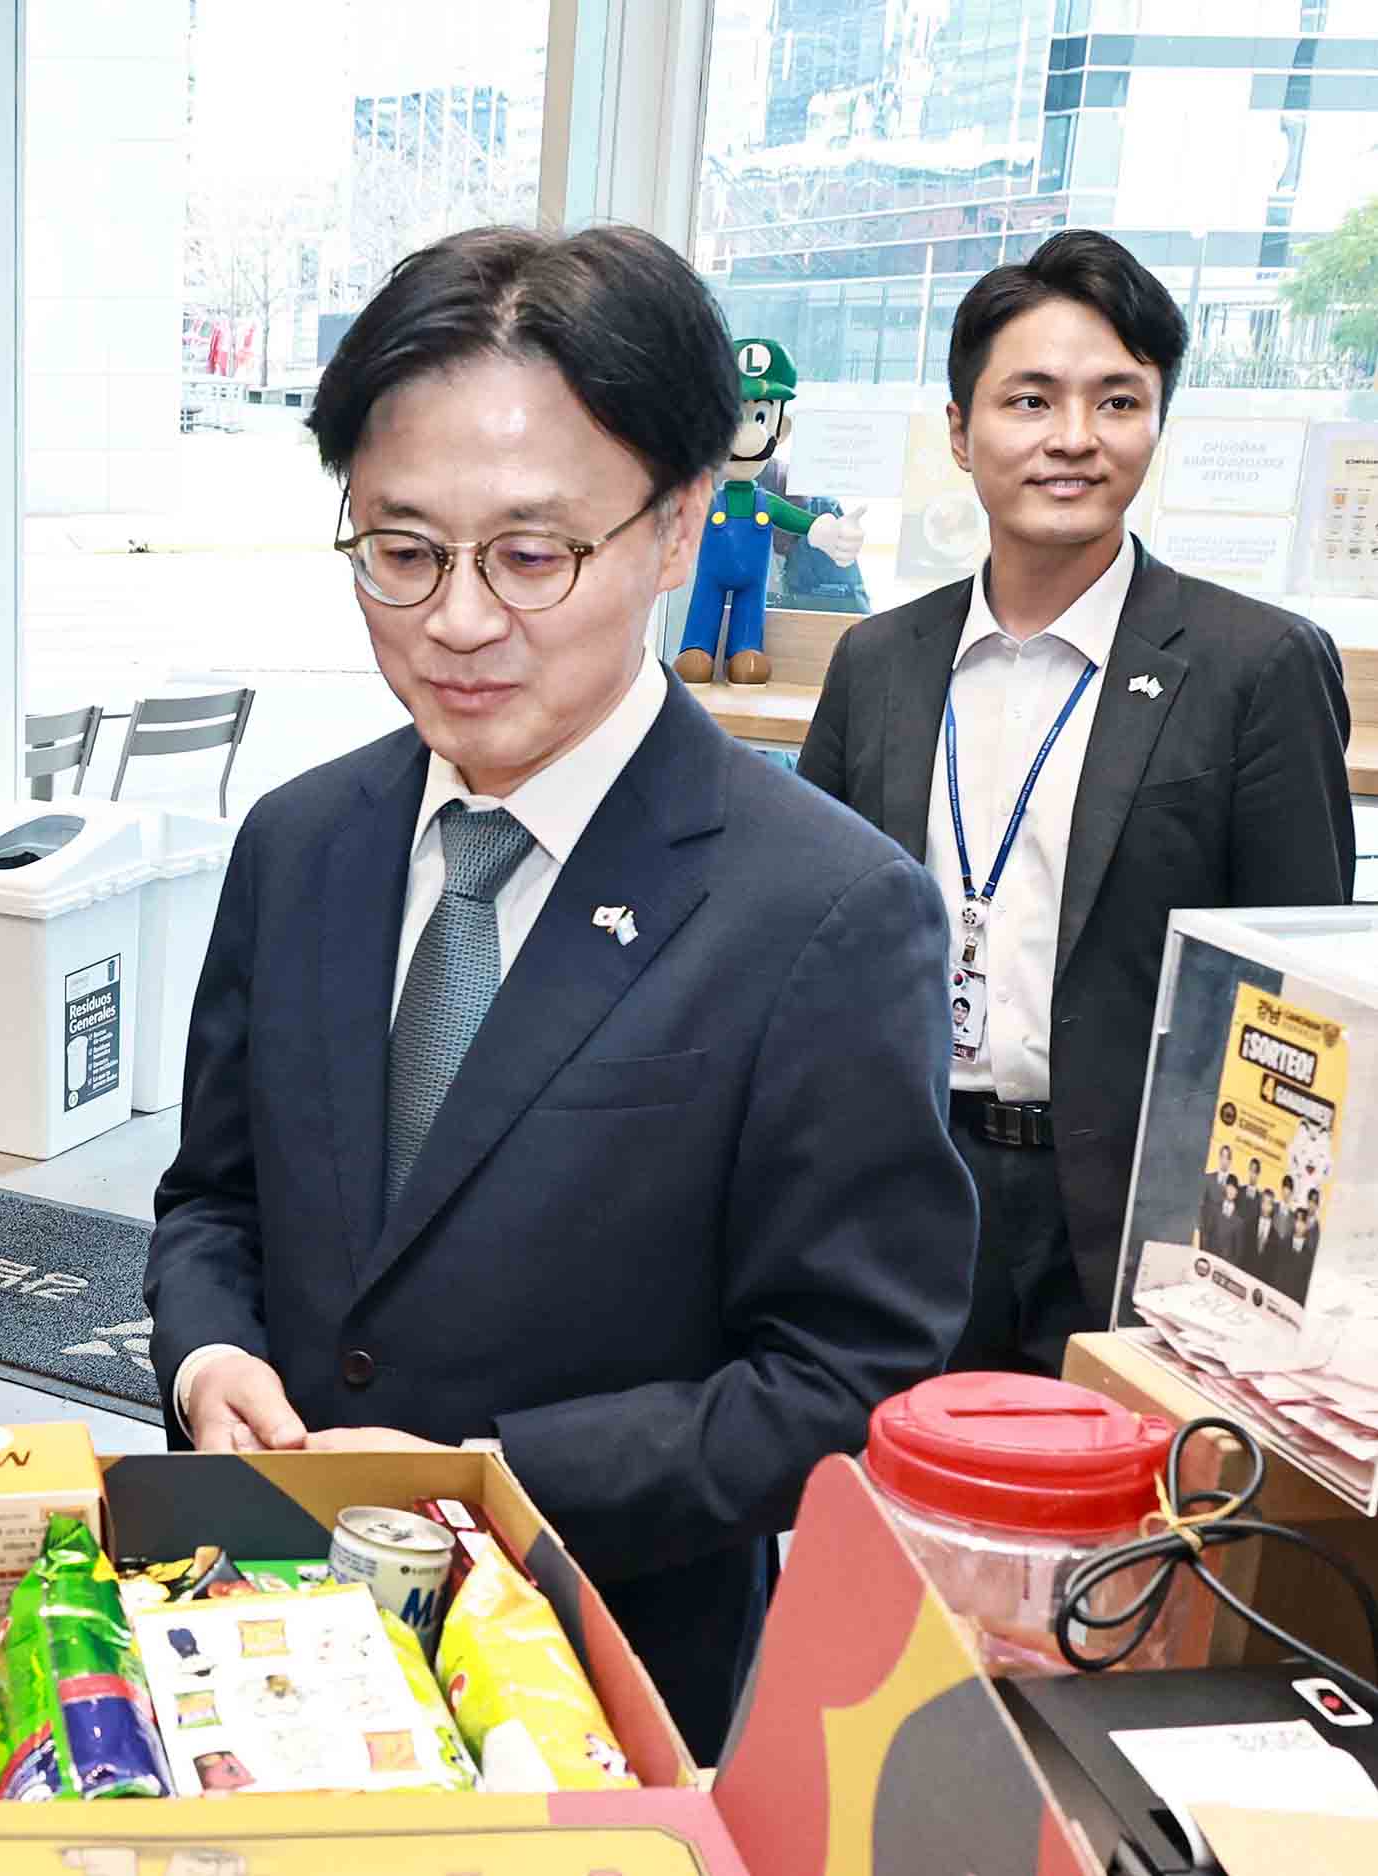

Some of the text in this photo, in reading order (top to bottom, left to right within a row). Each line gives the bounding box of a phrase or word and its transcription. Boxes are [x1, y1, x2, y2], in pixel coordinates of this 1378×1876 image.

[746, 347, 763, 373] L
[69, 991, 113, 1020] Residuos
[69, 1003, 116, 1035] Generales
